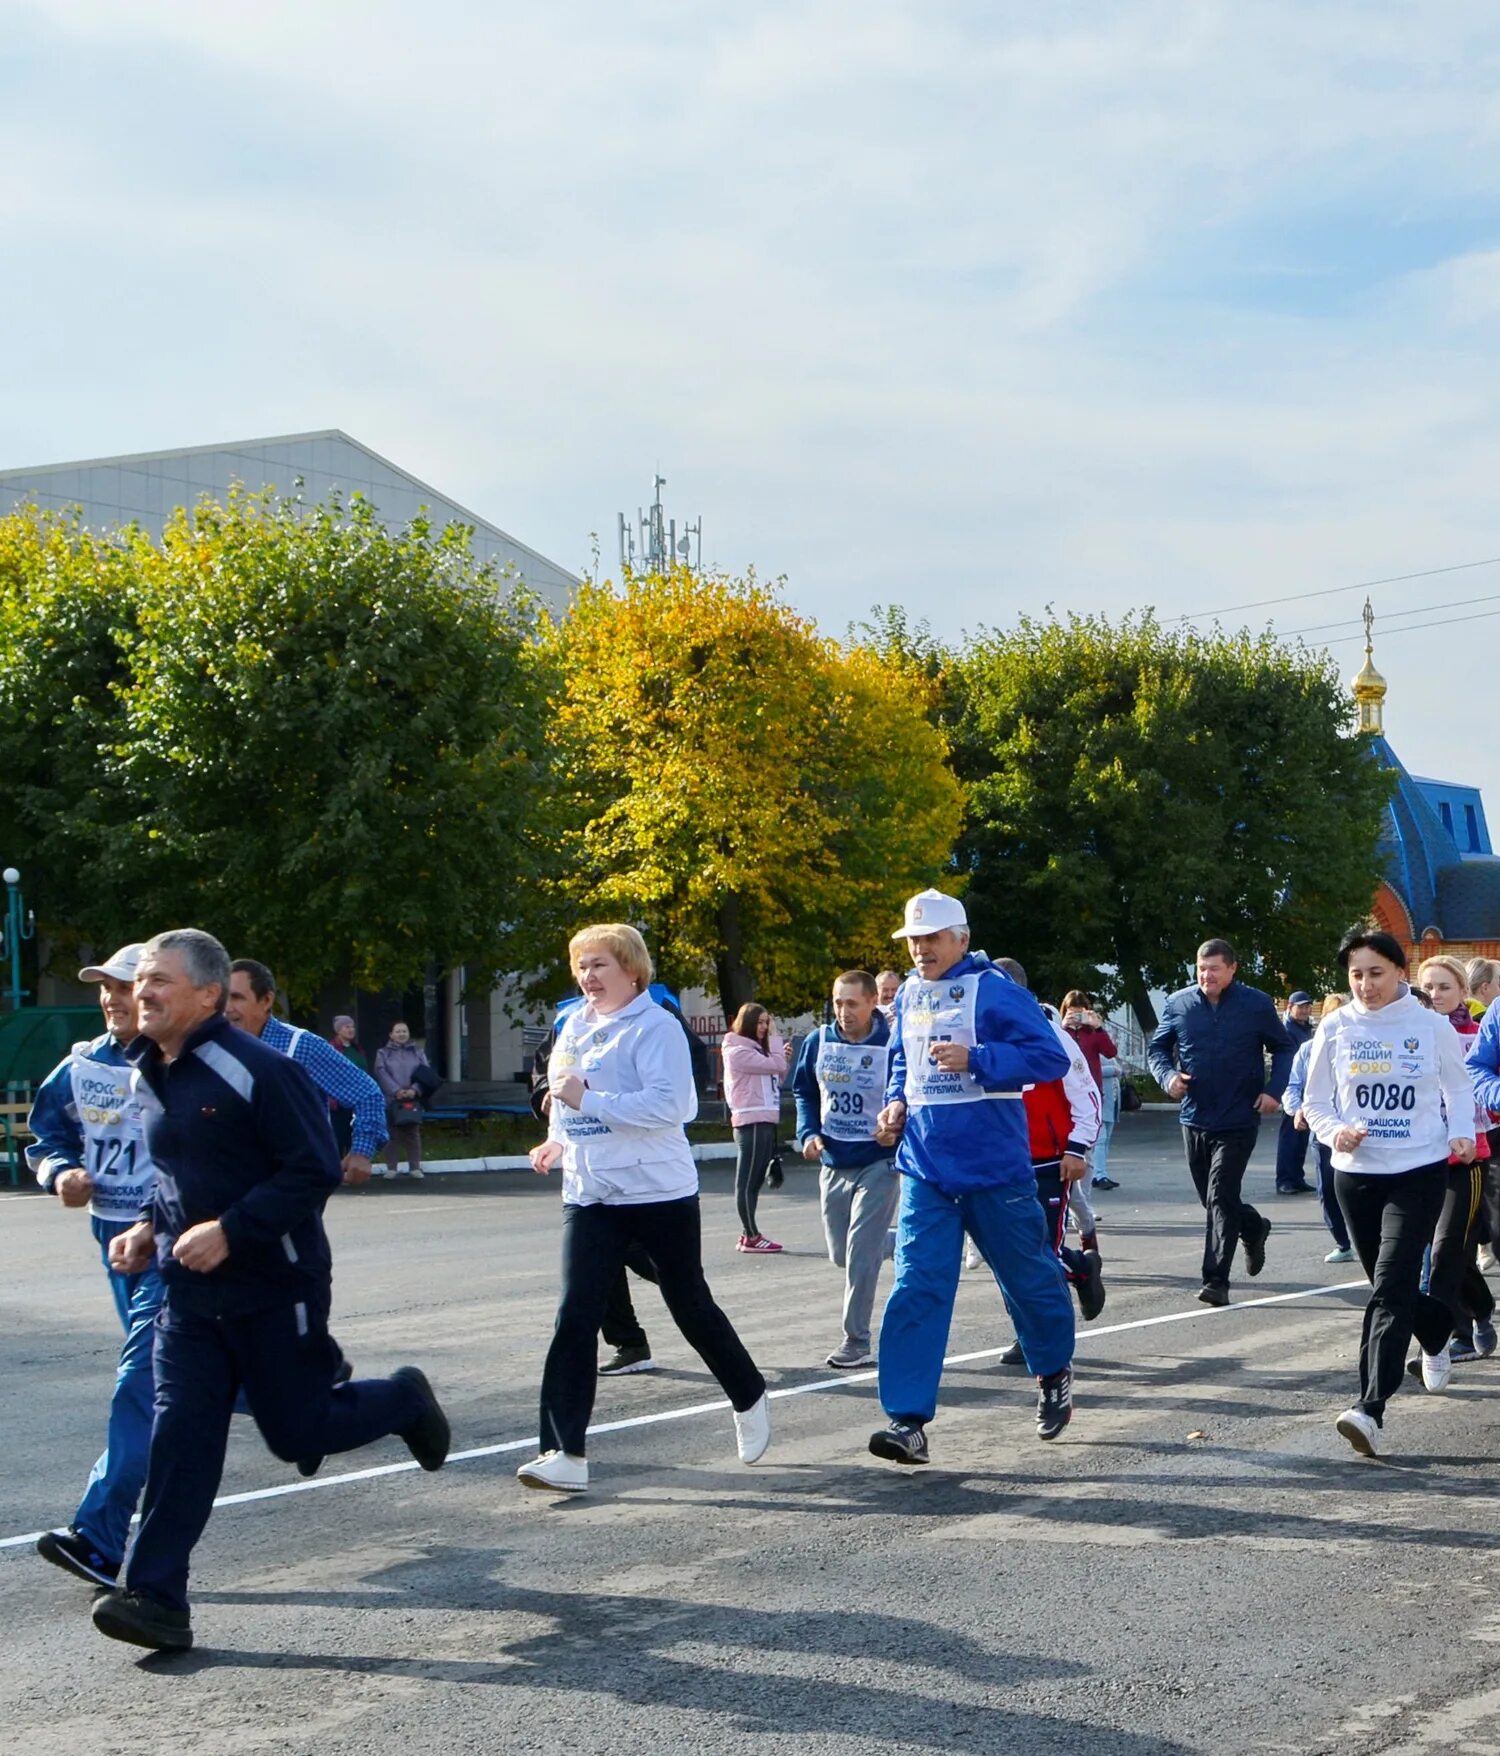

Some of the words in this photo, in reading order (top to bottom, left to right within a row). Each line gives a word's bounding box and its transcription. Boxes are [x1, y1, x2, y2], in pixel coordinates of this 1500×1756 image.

[1350, 1040, 1382, 1051] КРОСС
[1349, 1050, 1392, 1061] НАЦИИ
[1350, 1061, 1392, 1074] 2020
[81, 1078, 117, 1096] КРОСС
[80, 1092, 125, 1110] НАЦИИ
[1355, 1083, 1416, 1111] 6080
[92, 1138, 137, 1176] 721
